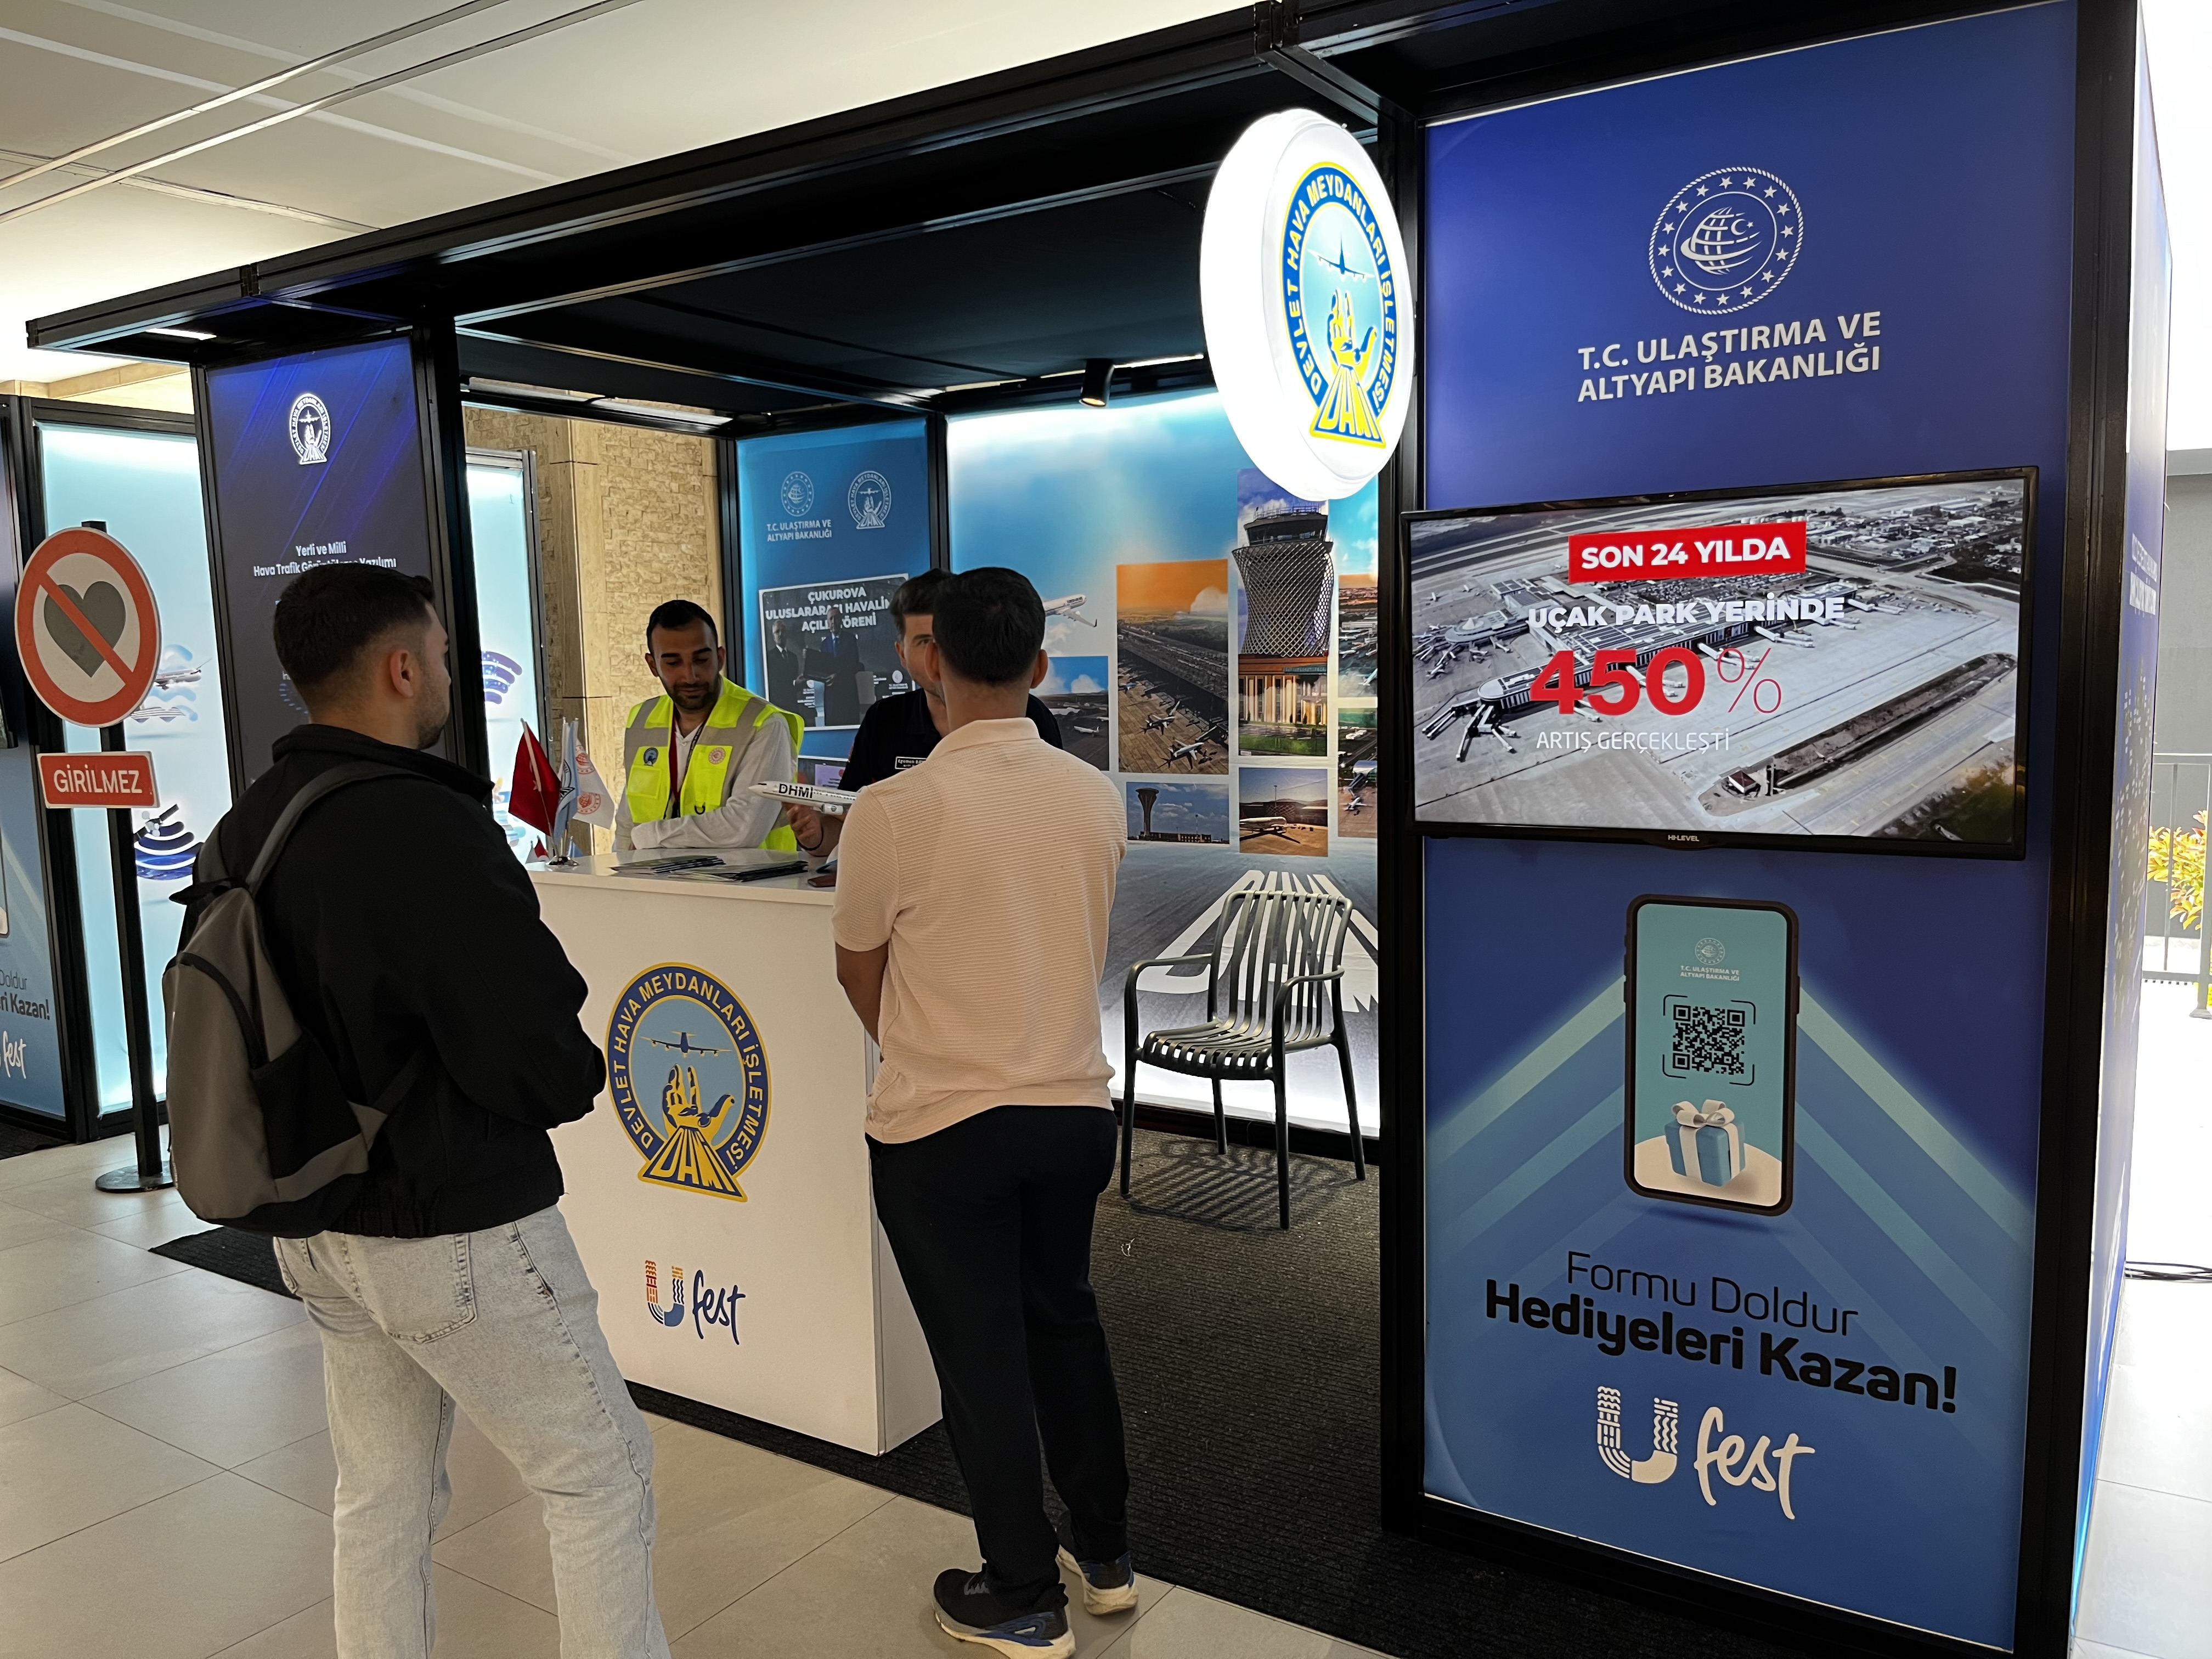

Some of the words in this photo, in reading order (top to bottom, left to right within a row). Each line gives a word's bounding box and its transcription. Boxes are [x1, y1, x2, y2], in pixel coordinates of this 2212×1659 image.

[1287, 199, 1310, 270] HAVA
[1306, 174, 1386, 266] MEYDANLARI
[1287, 278, 1322, 395] DEVLET
[1578, 343, 1629, 370] T.C.
[1637, 318, 1827, 363] ULAŞTIRMA
[1837, 311, 1881, 340] VE
[1577, 367, 1695, 403] ALTYAPI
[1704, 341, 1880, 390] BAKANLIĞI
[767, 532, 794, 542] ALTYAPI
[794, 528, 832, 540] BAKANLIĞI
[780, 520, 821, 532] ULAŞTIRMA
[821, 519, 832, 528] VE
[253, 566, 275, 576] Hava
[276, 562, 301, 575] Trafik
[295, 543, 316, 557] Yerli
[316, 546, 328, 555] ve
[328, 541, 347, 555] Milli
[1581, 543, 1644, 569] SON
[1650, 542, 1689, 566] 24
[1694, 537, 1791, 563] YILDA
[808, 586, 867, 604] ÇUKUROVA
[1527, 605, 1614, 634] UÇAK
[1616, 603, 1698, 625] PARK
[1705, 592, 1846, 623] YERİNDE
[840, 612, 877, 629] ÖRENİ
[1536, 731, 1592, 753] ARTIŞ
[1597, 728, 1729, 754] GERÇEKLEŞTİ
[54, 764, 143, 794] GİRİLMEZ
[778, 783, 814, 798] DHMİ
[10, 992, 50, 1020] Kazan!
[613, 998, 642, 1053] HAVA
[638, 972, 750, 1041] MEYDANLARI
[3, 1030, 27, 1079] fest
[613, 1060, 654, 1149] DEVLET
[725, 1043, 763, 1170] İŞLETMESİ
[1567, 1250, 1696, 1307] Formu
[1711, 1276, 1859, 1336] Doldur
[1486, 1278, 1743, 1370] Hediyeleri
[1759, 1332, 1957, 1414] Kazan!
